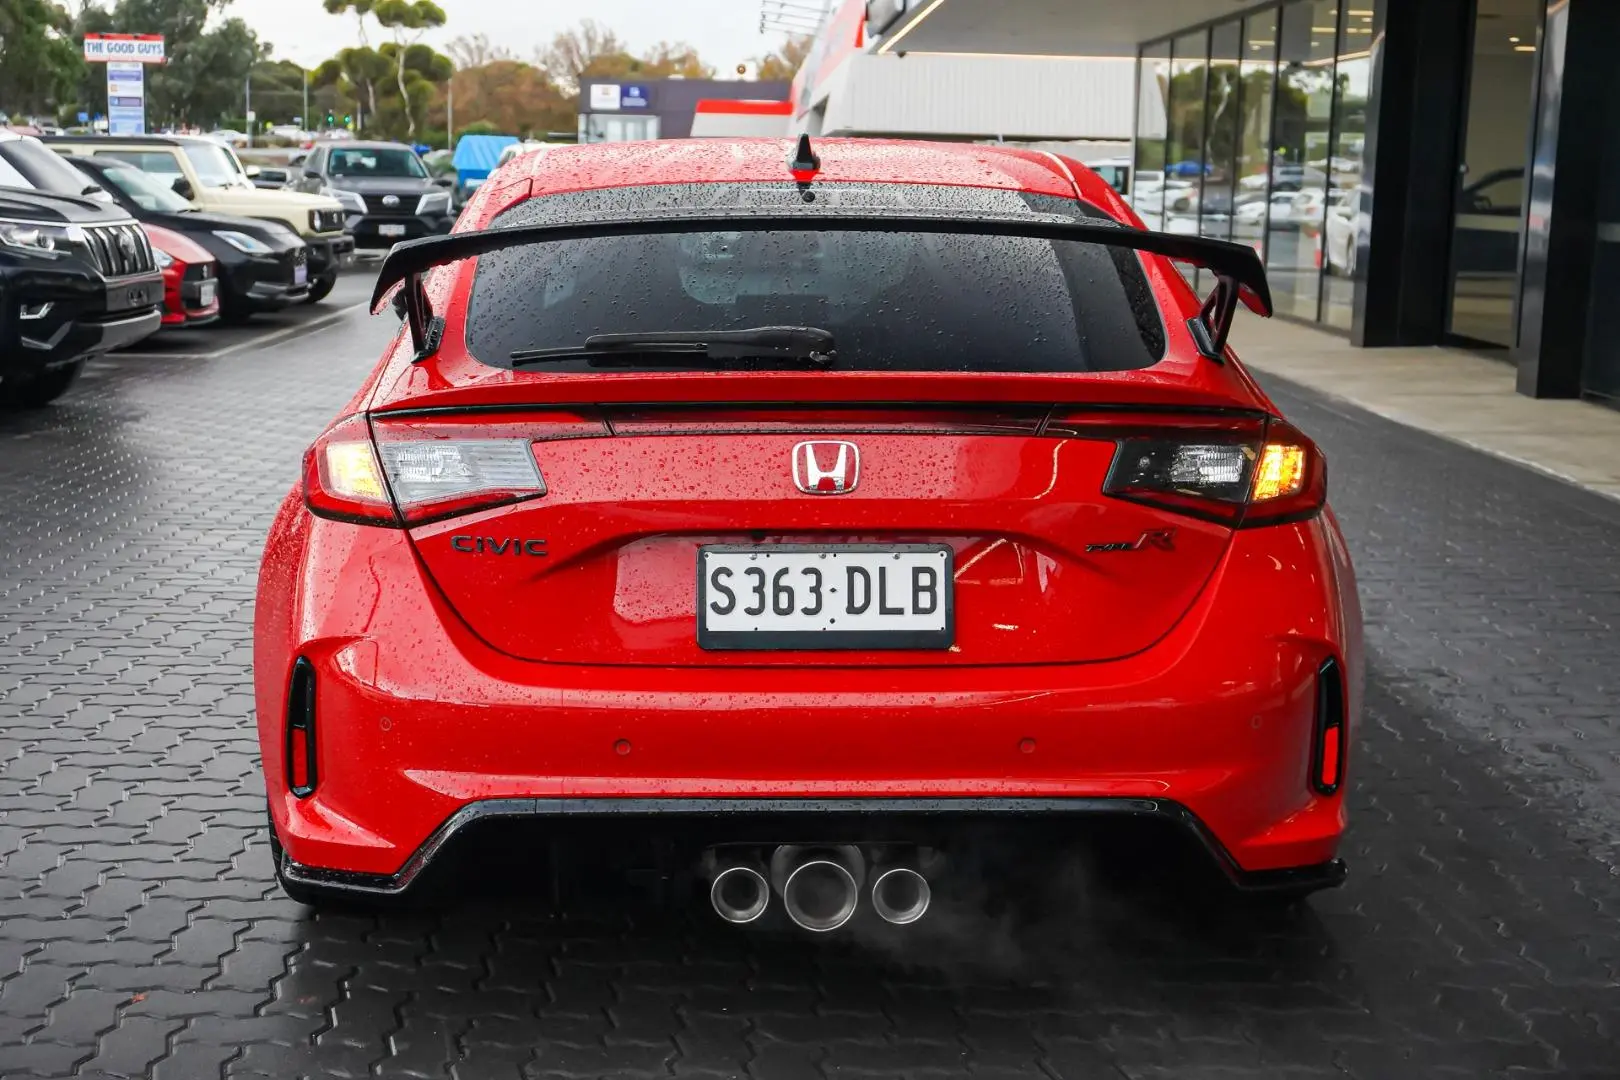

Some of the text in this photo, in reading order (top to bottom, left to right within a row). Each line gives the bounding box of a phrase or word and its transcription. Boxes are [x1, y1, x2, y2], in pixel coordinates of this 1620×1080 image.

[87, 42, 162, 54] THE GOOD GUYS
[451, 535, 548, 556] CIVIC
